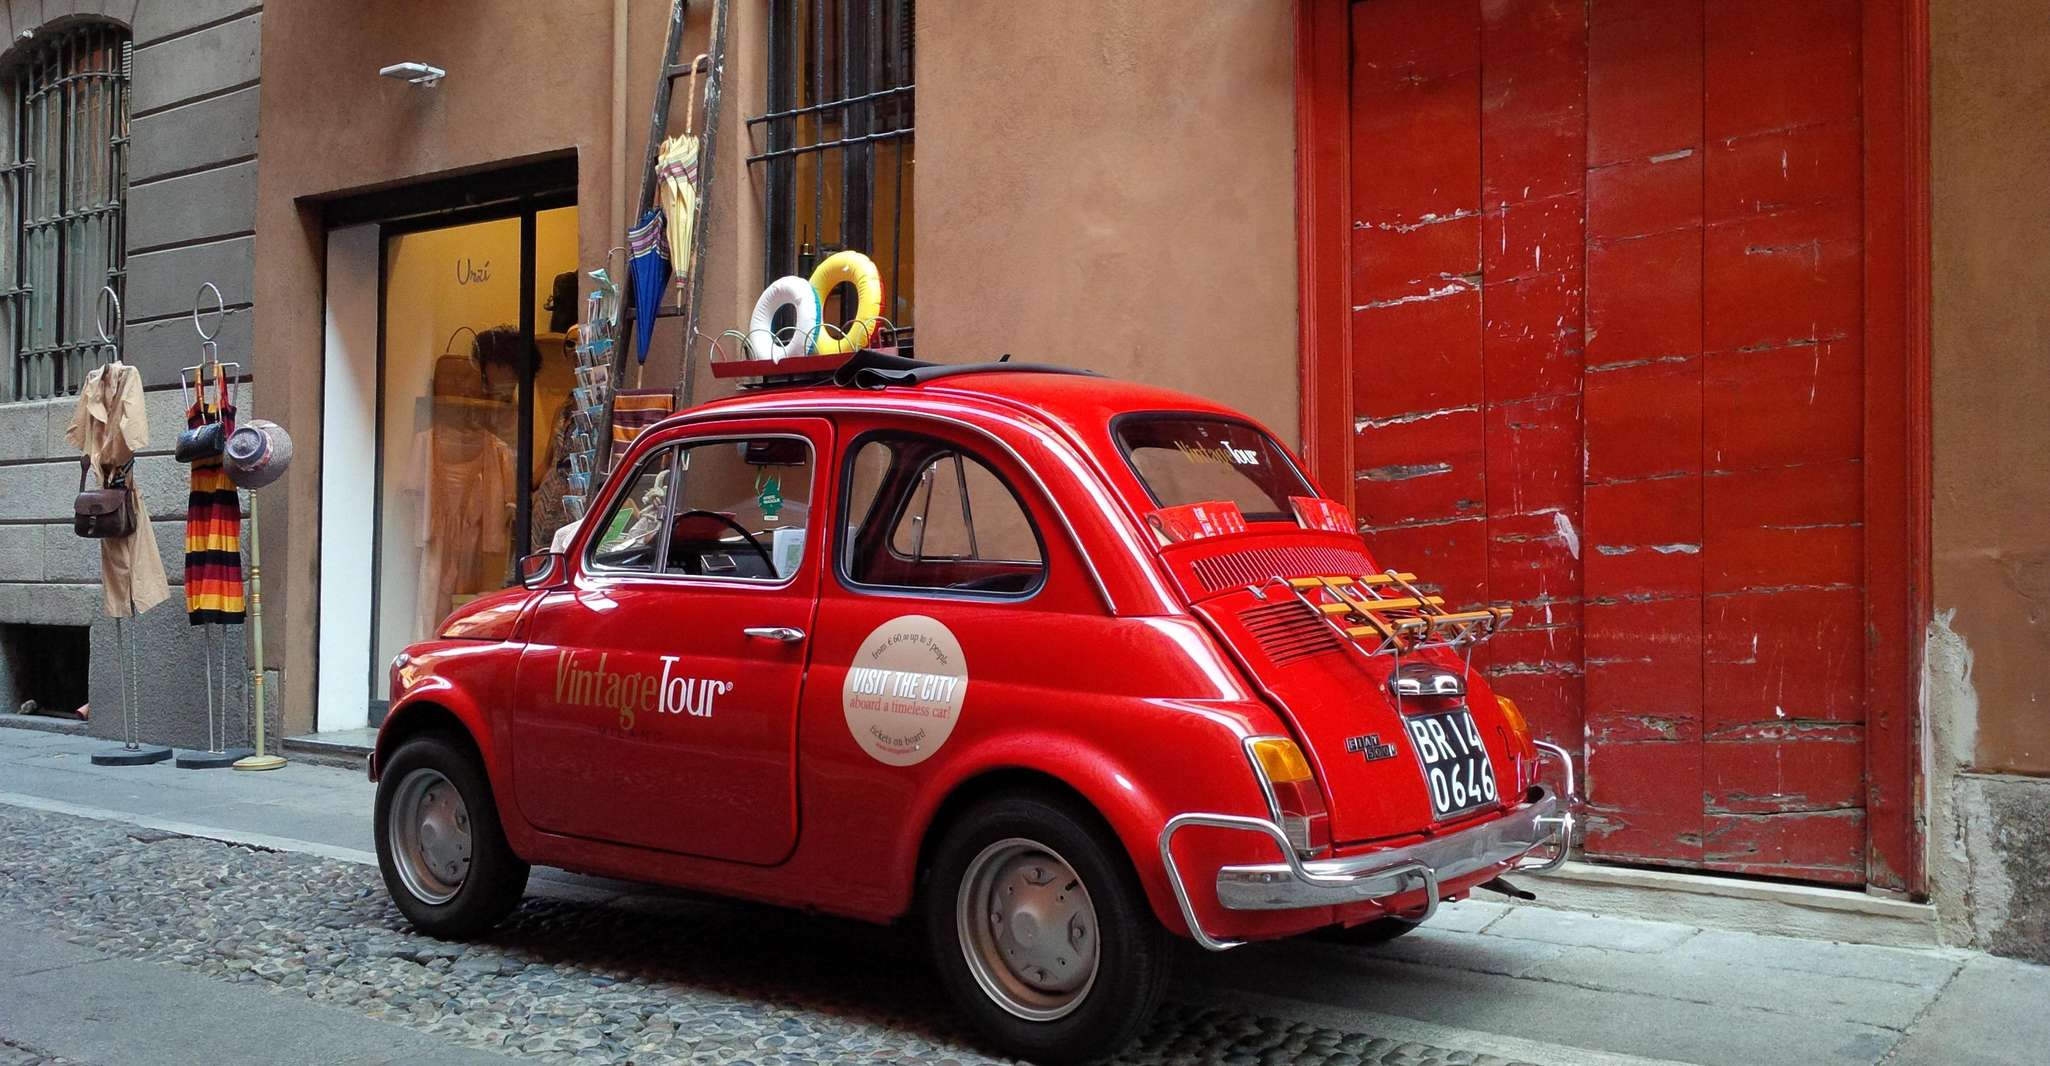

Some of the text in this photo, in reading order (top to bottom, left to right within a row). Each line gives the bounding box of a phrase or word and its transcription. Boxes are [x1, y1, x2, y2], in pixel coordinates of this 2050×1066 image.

[871, 643, 888, 660] from
[910, 632, 919, 644] up
[919, 633, 927, 644] to
[929, 643, 948, 666] people
[852, 667, 959, 703] VISIT THE CITY
[849, 695, 882, 712] aboard
[882, 702, 889, 713] a
[891, 699, 930, 718] timeless
[870, 724, 927, 746] tickets on board
[1348, 735, 1378, 750] FIAT
[1410, 718, 1457, 765] BR
[1430, 757, 1496, 813] 0646
